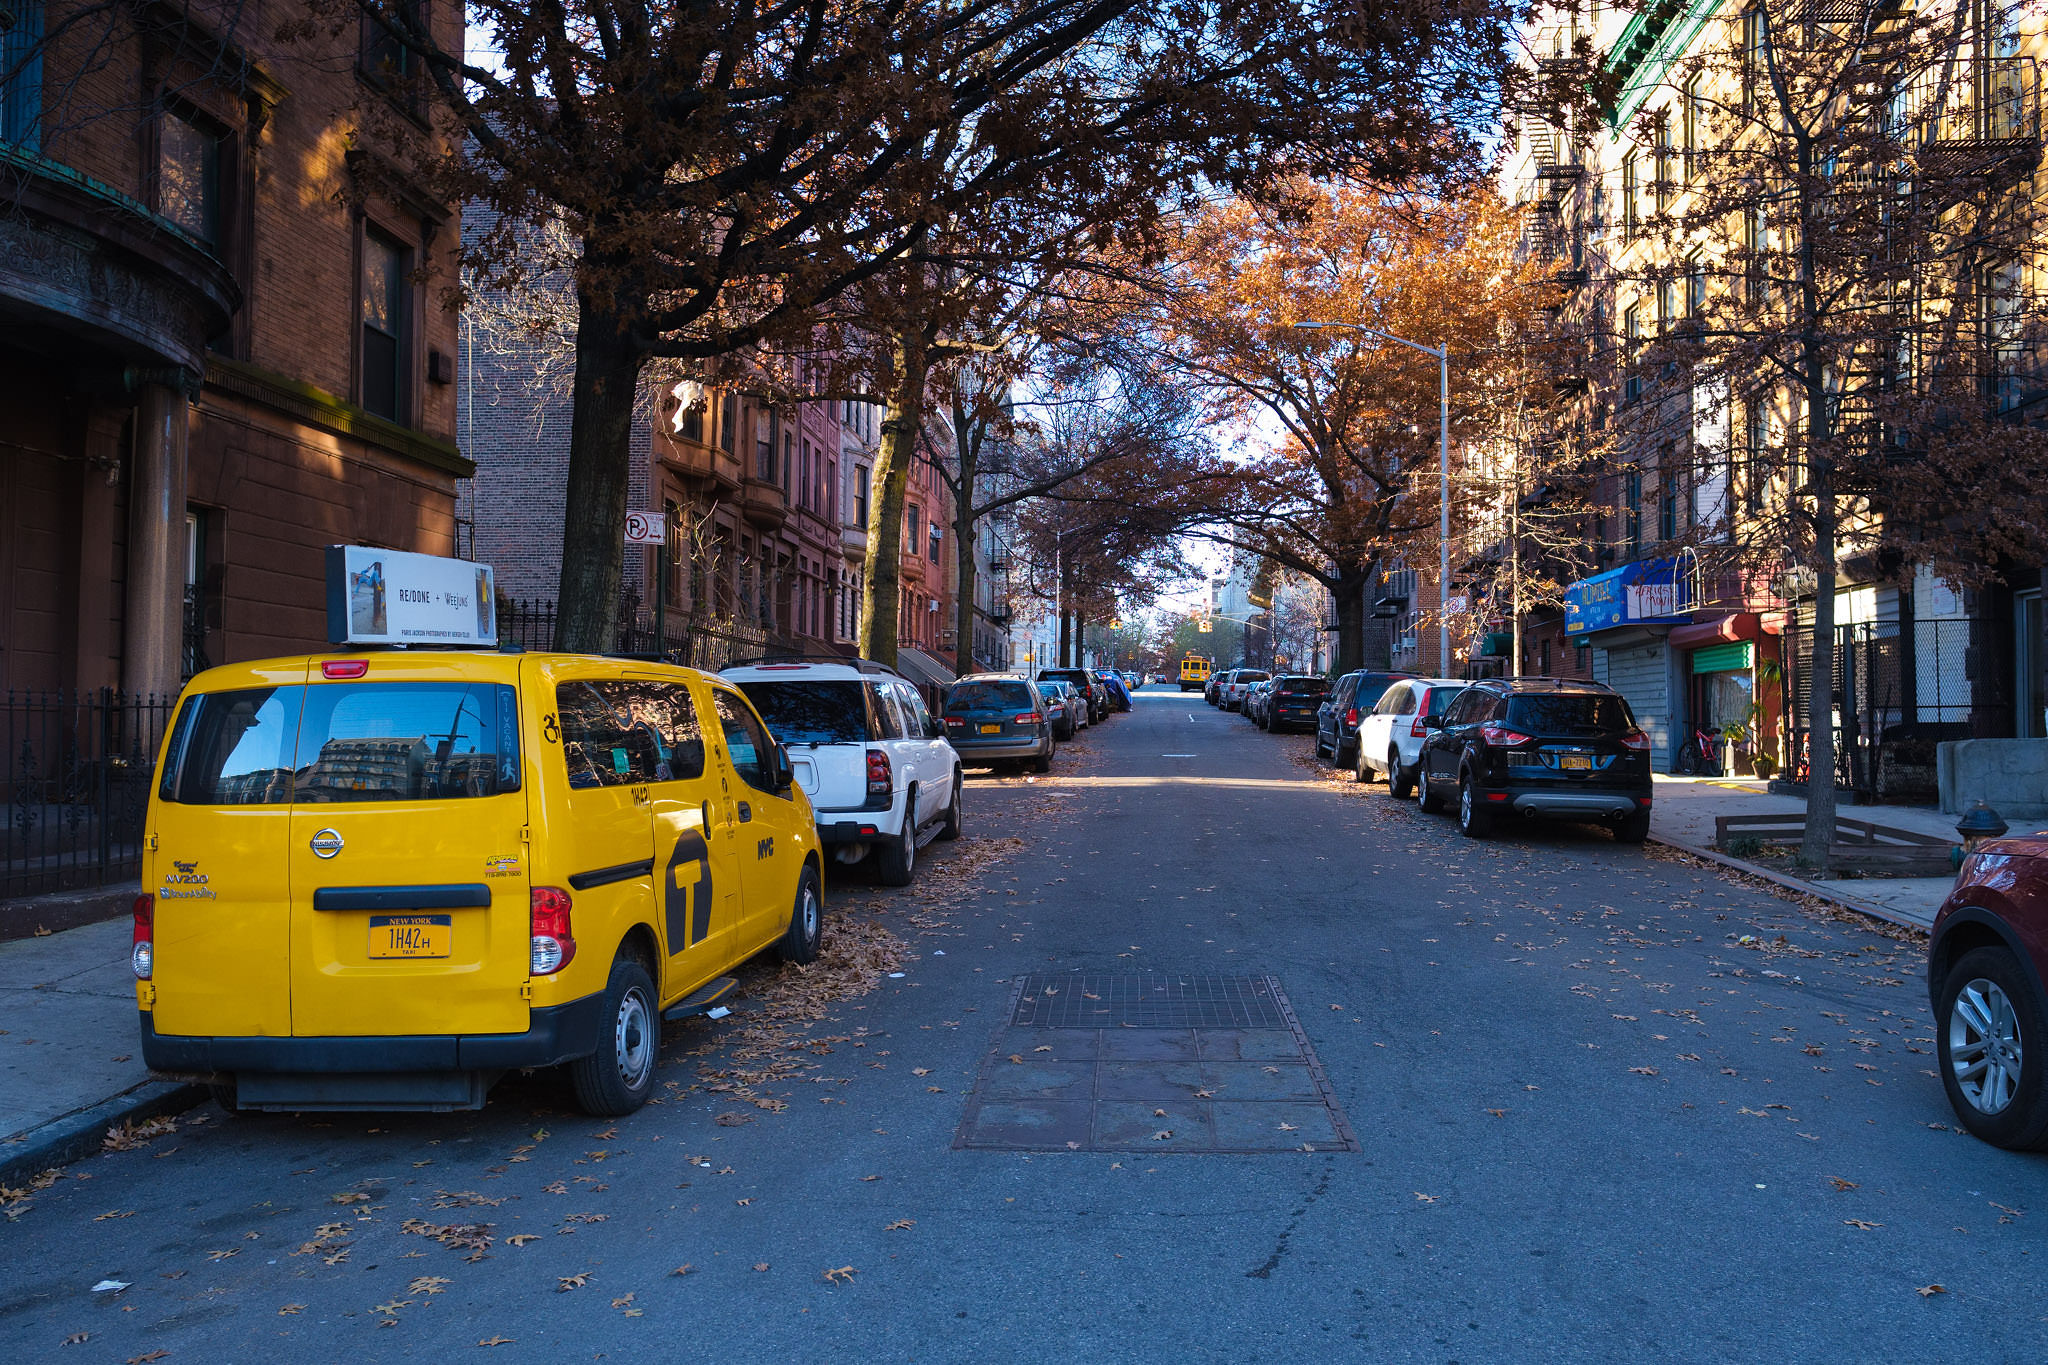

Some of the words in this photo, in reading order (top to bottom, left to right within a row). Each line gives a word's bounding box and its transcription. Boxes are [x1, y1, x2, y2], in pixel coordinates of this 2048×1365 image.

[399, 588, 430, 604] RE/DONE
[757, 836, 774, 861] NYC
[165, 874, 209, 884] NV200
[389, 917, 409, 926] NEW
[410, 917, 432, 925] YORK
[389, 927, 430, 949] 1H42H
